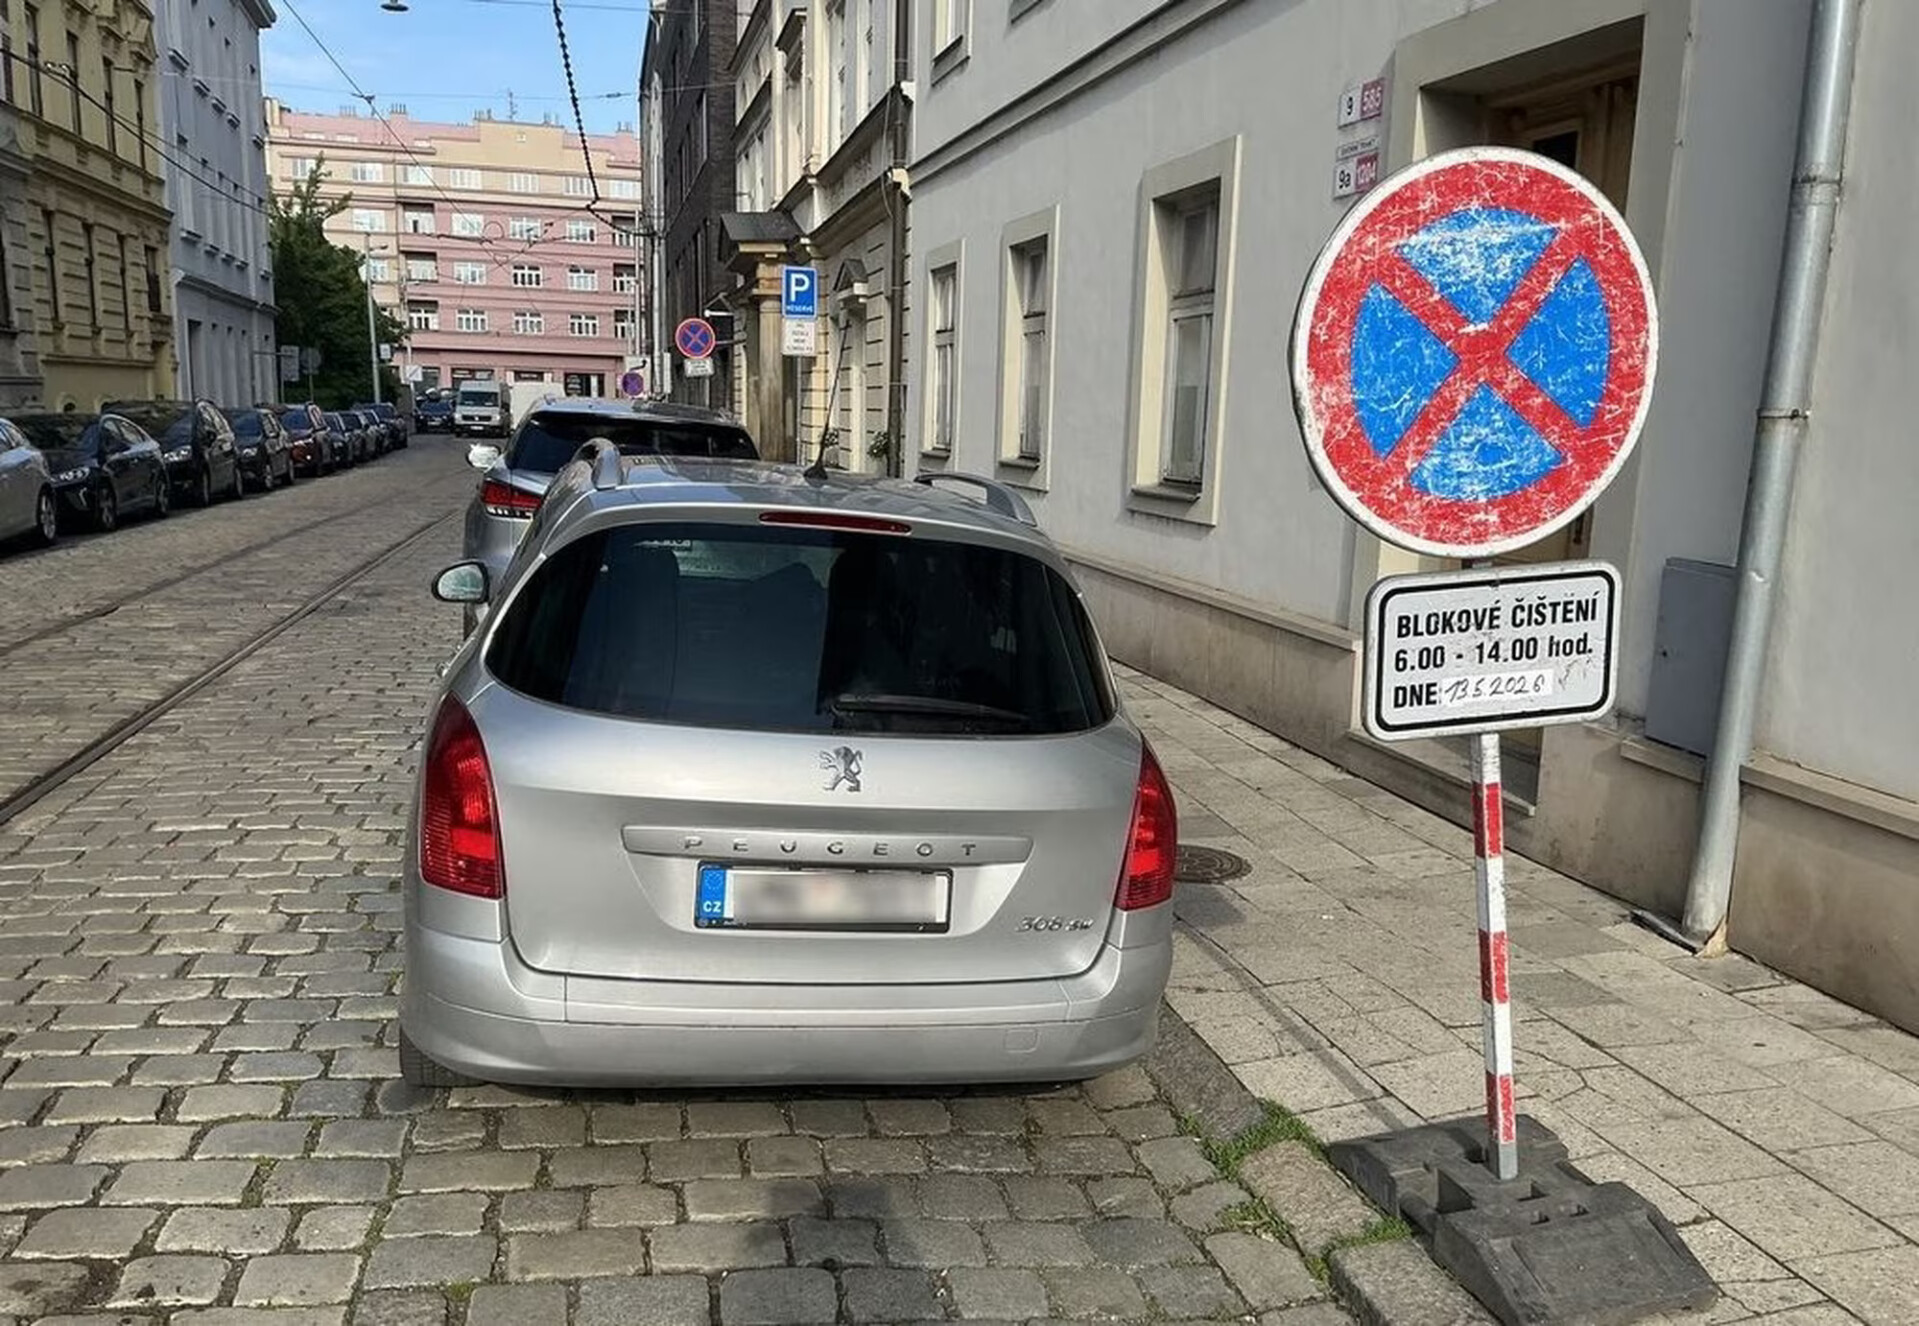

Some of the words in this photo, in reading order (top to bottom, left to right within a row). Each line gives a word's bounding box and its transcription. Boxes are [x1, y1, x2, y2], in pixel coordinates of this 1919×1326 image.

[1347, 96, 1353, 115] 9
[1339, 169, 1351, 190] 9a
[790, 273, 810, 302] P
[1396, 599, 1502, 639] BLOKOVÉ
[1394, 647, 1446, 673] 6.00
[1475, 636, 1539, 665] 14.00
[1547, 632, 1593, 658] hod.
[683, 836, 976, 857] PEUGEOT
[702, 901, 722, 913] CZ
[1014, 915, 1062, 933] 308
